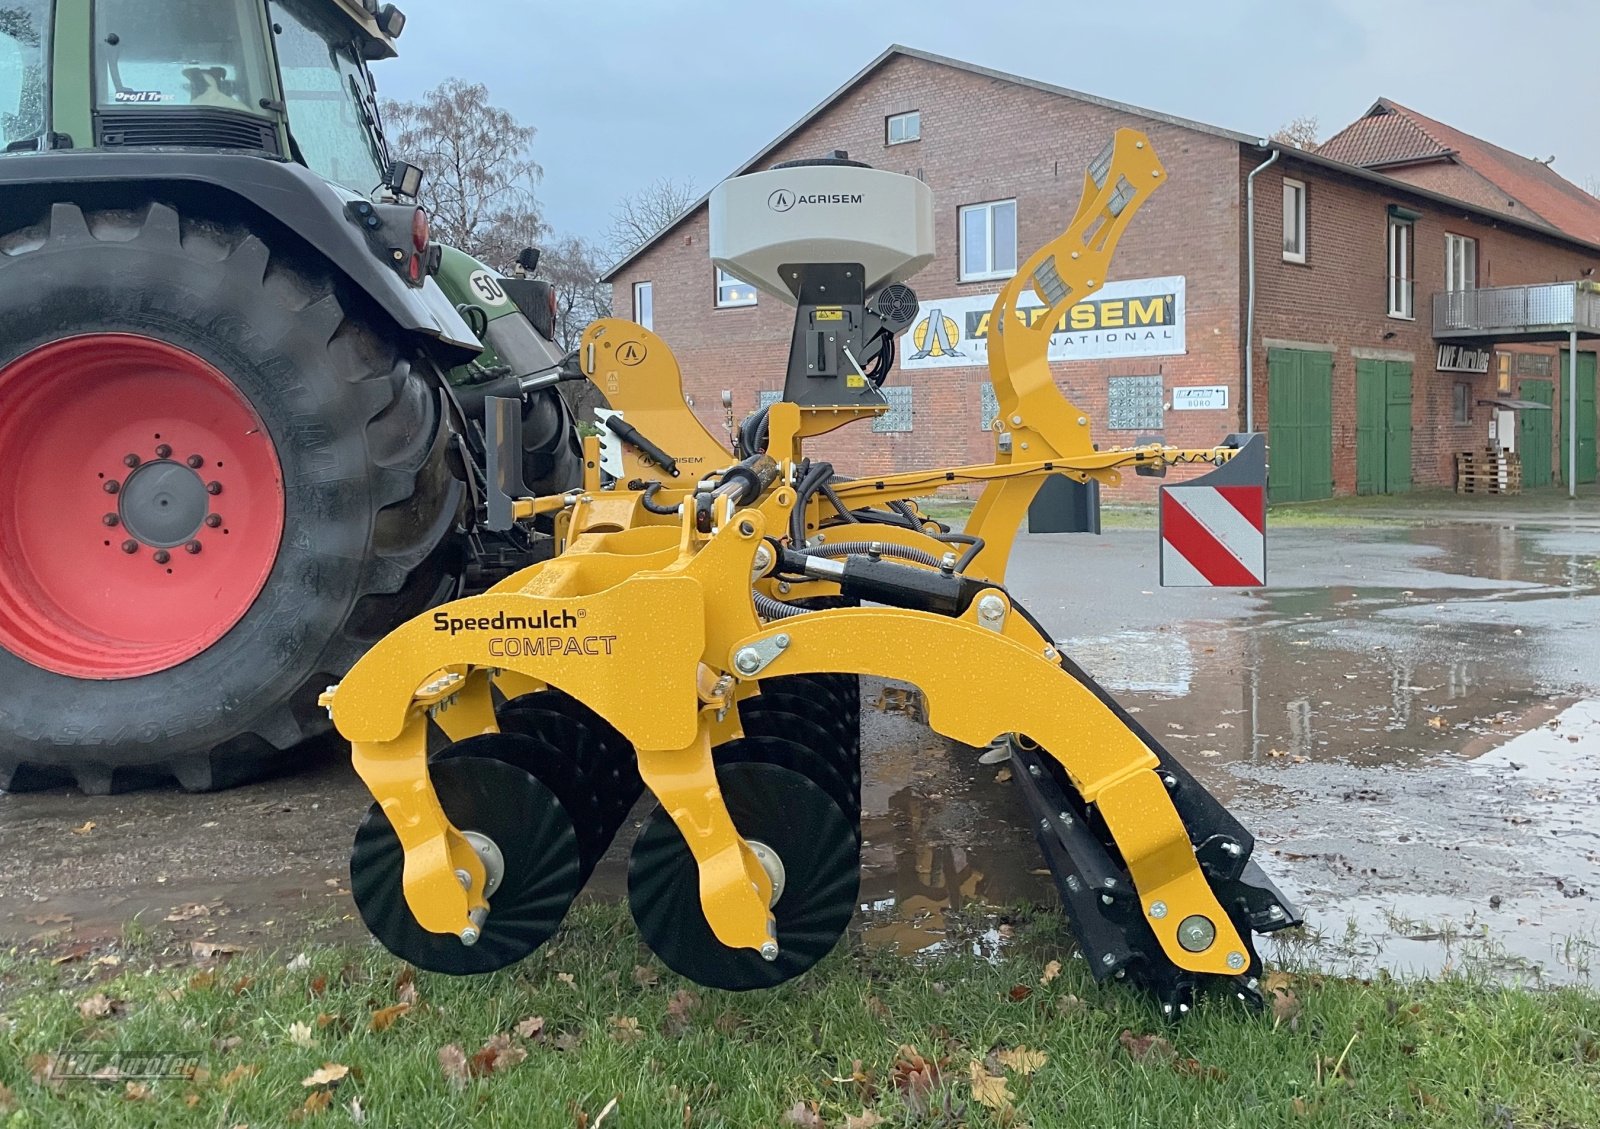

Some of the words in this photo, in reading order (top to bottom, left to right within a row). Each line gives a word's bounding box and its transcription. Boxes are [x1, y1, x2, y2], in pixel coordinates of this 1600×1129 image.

[798, 194, 862, 204] AGRISEM
[472, 274, 504, 301] 50
[488, 635, 617, 657] COMPACT
